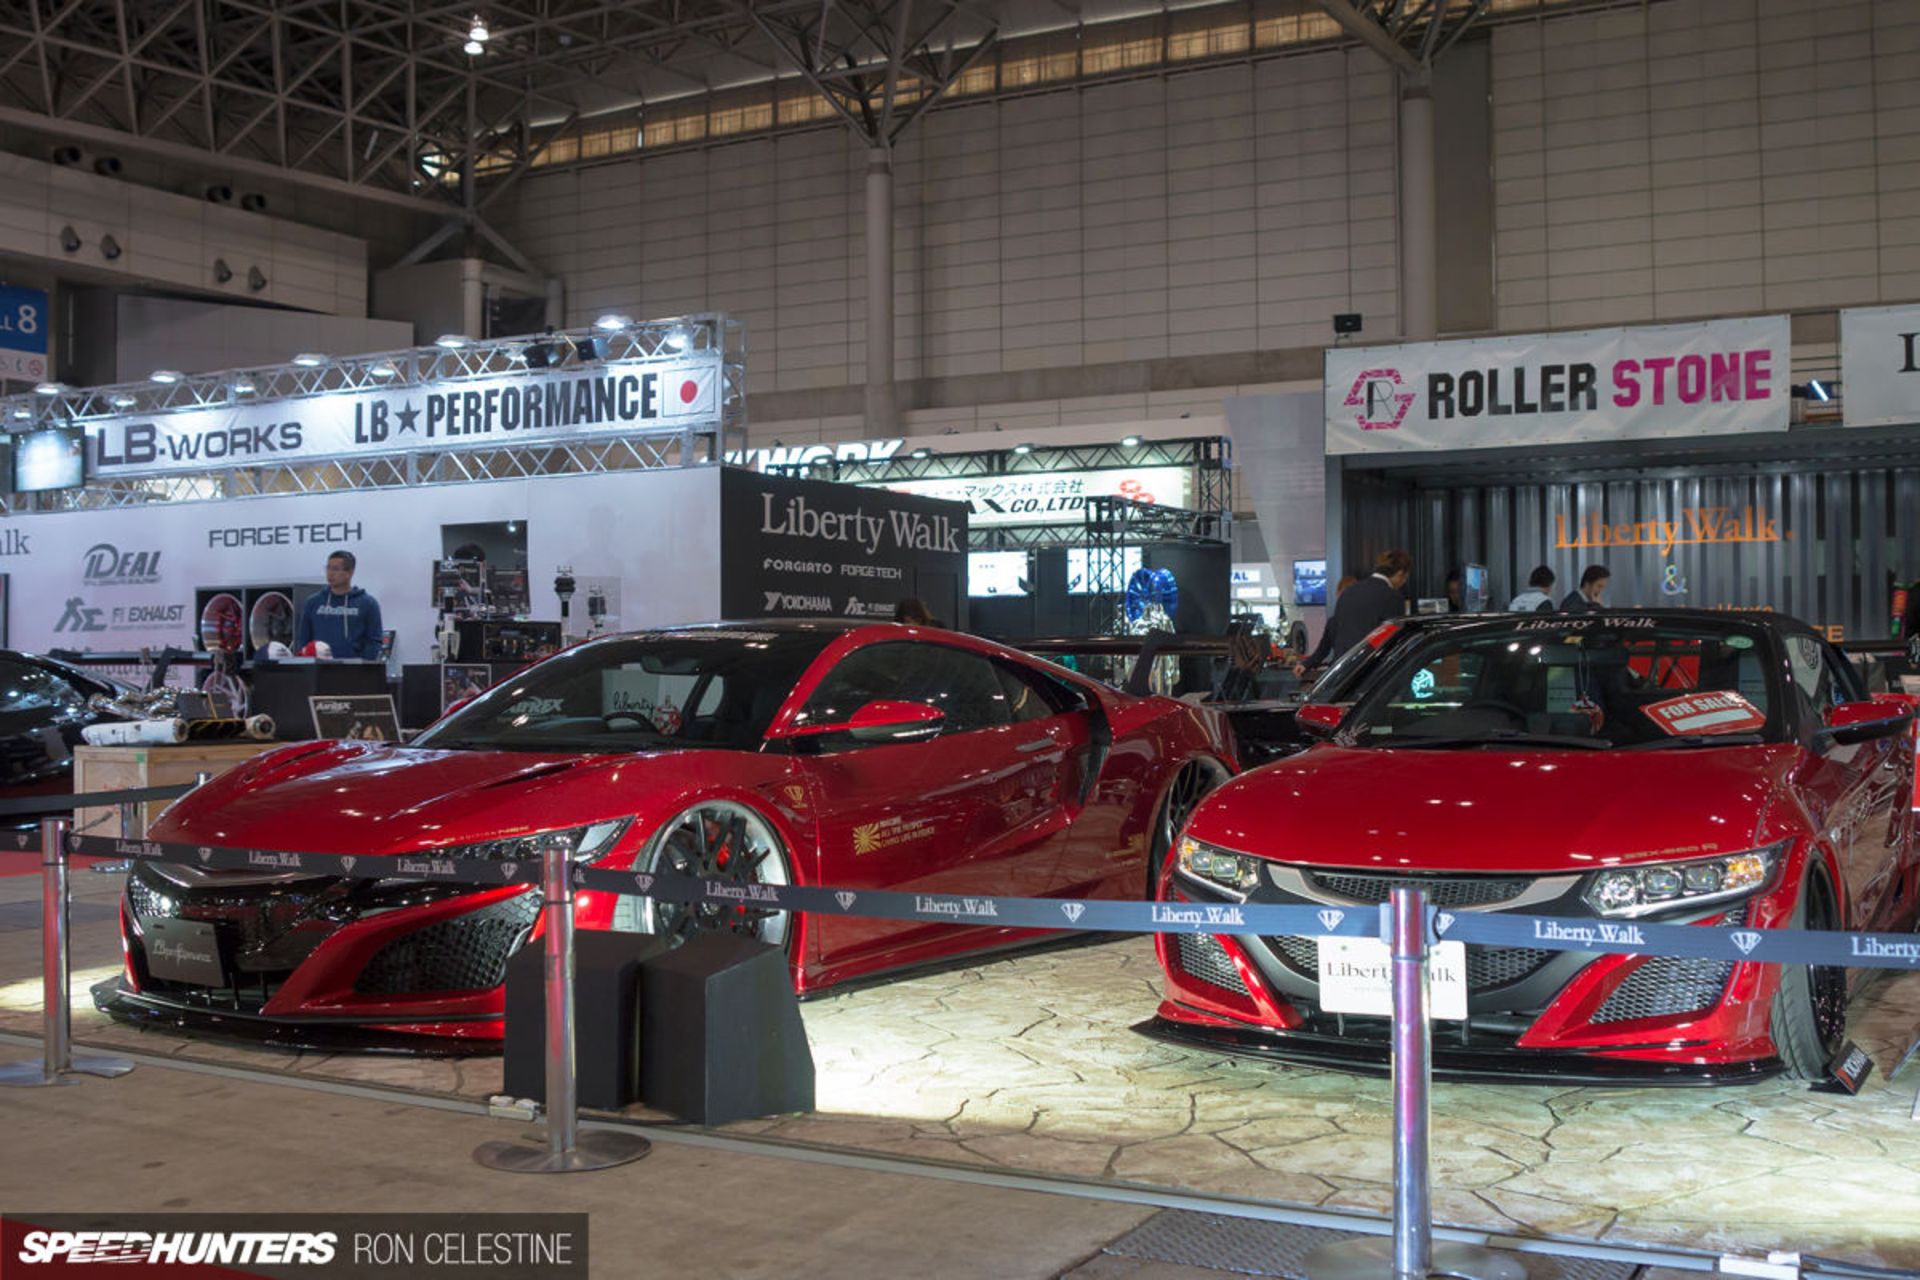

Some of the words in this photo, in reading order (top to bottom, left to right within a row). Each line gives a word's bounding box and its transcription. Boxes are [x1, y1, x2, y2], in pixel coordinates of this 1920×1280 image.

[18, 304, 37, 334] 8
[1428, 363, 1597, 419] ROLLER
[1613, 349, 1772, 407] STONE
[355, 400, 389, 443] LB
[427, 373, 657, 437] PERFORMANCE
[209, 526, 290, 549] FORGE
[293, 521, 362, 544] TECH
[760, 492, 886, 555] Liberty
[889, 510, 961, 553] Walk
[1555, 511, 1681, 557] Liberty
[1683, 505, 1781, 542] Walk
[763, 558, 833, 575] FORGIATO
[1661, 564, 1688, 595] &
[128, 604, 186, 622] EXHAUST
[781, 593, 833, 612] YOKOHAMA
[1515, 619, 1594, 631] Liberty
[1603, 618, 1657, 629] Walk
[1658, 702, 1697, 719] FOR
[705, 881, 748, 902] Liberty
[749, 884, 779, 901] Walk
[915, 896, 962, 918] Liberty
[962, 898, 998, 916] Walk
[1152, 905, 1203, 929] Liberty
[1206, 906, 1245, 925] Walk
[1534, 920, 1597, 947] Liberty
[1598, 923, 1645, 945] Walk
